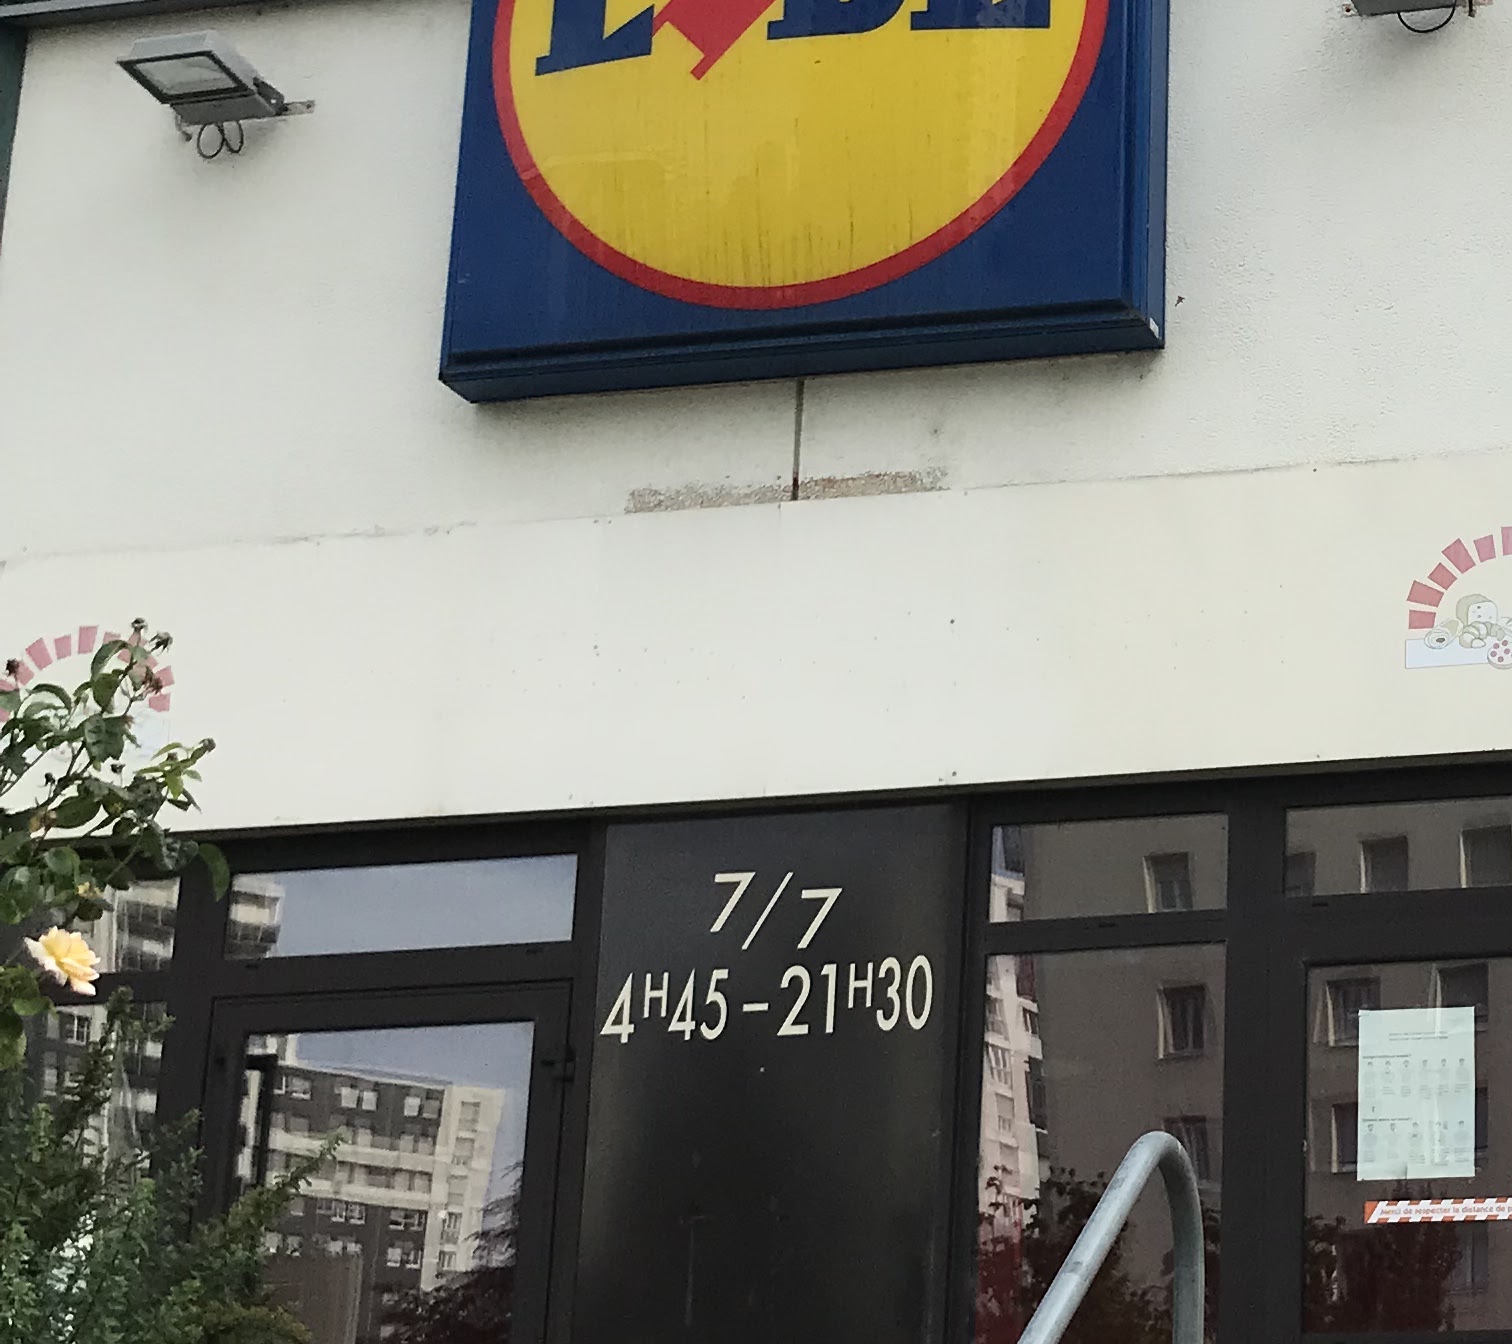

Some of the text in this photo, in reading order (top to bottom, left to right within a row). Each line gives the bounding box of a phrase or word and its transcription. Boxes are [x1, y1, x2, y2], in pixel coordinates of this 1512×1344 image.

[710, 871, 842, 950] 7/7
[1402, 1207, 1413, 1215] de
[1415, 1206, 1451, 1216] respecter
[1461, 1204, 1494, 1213] distance
[1495, 1204, 1506, 1212] de
